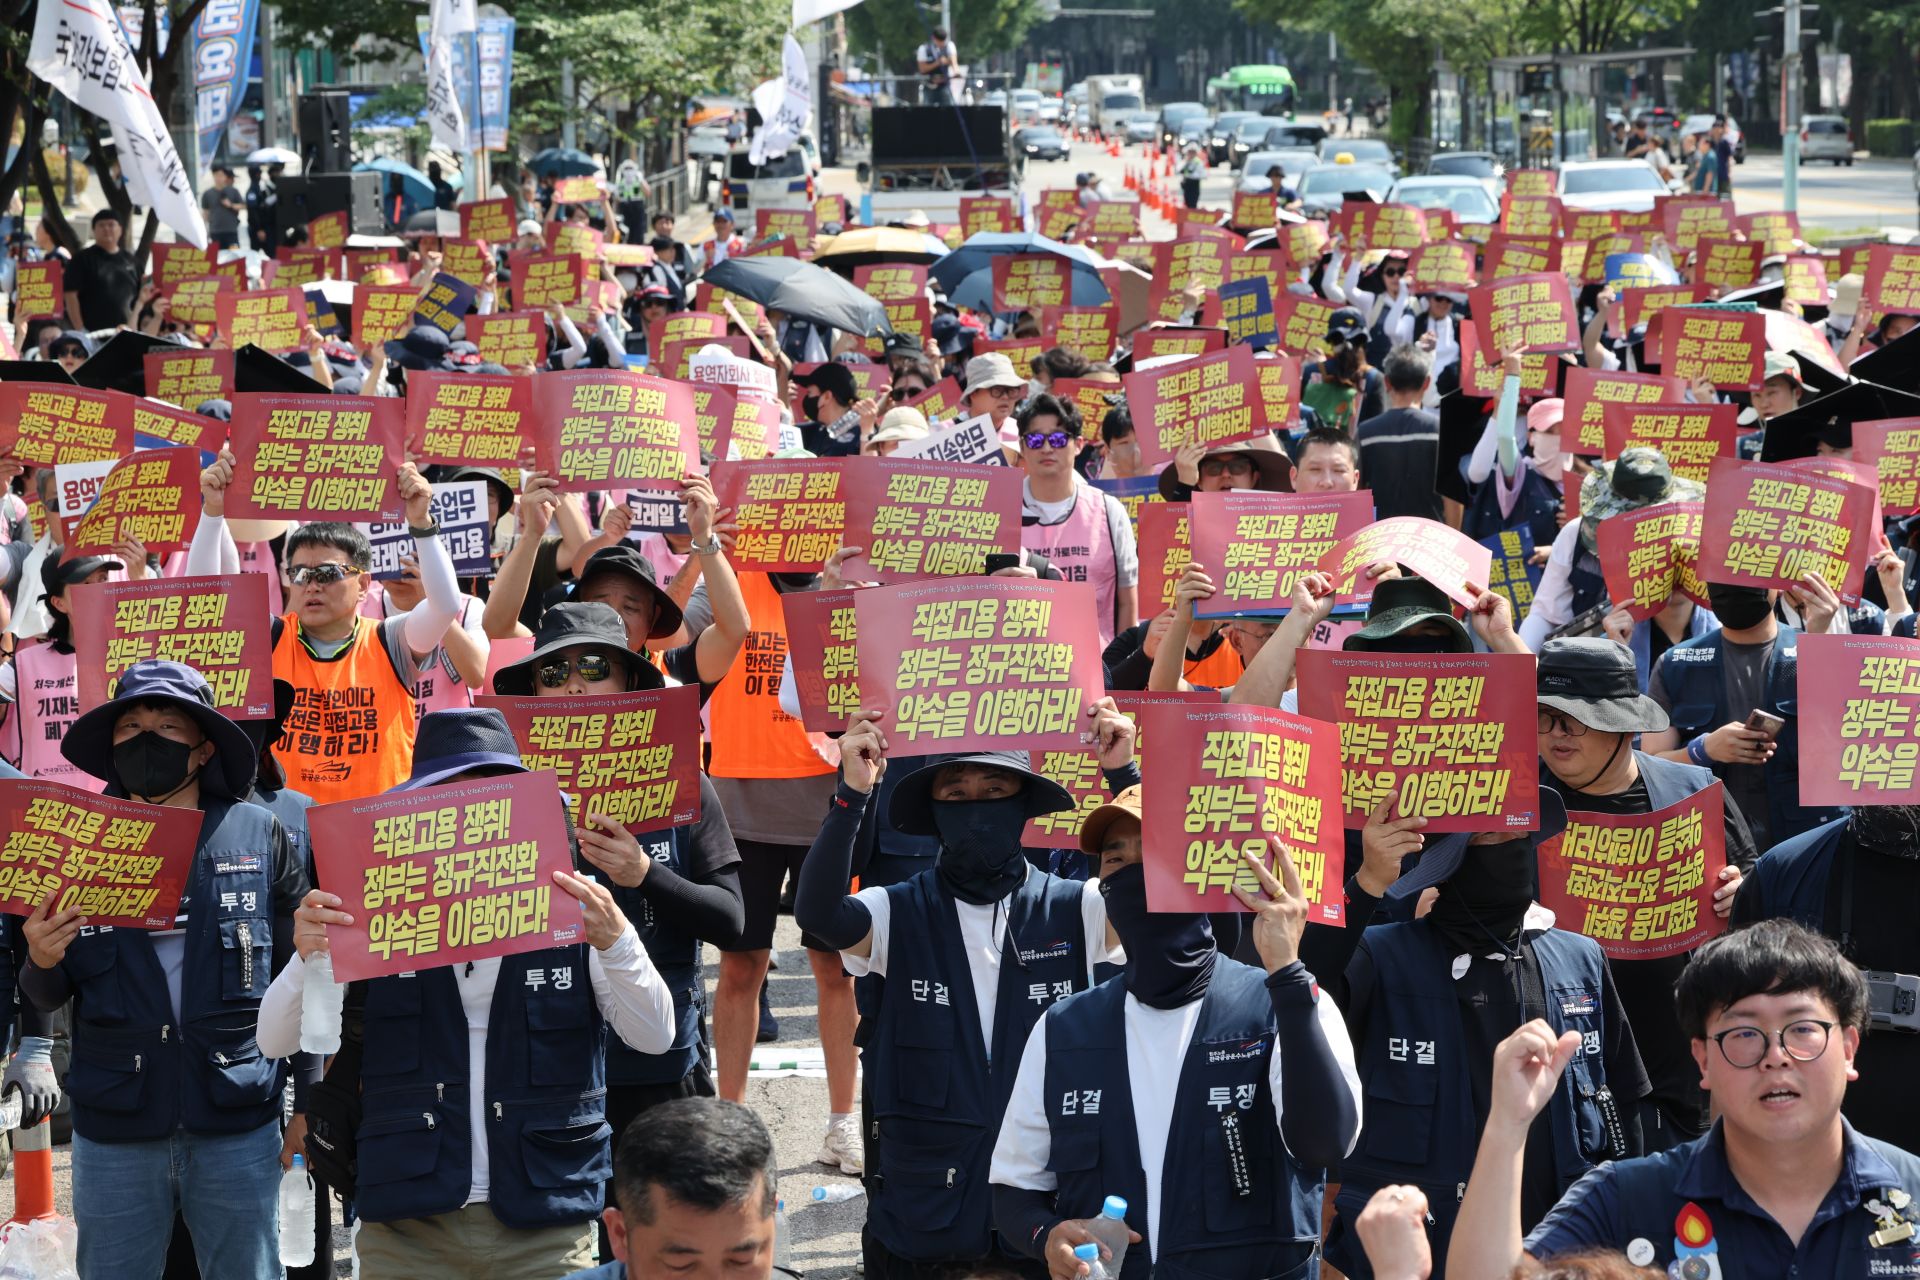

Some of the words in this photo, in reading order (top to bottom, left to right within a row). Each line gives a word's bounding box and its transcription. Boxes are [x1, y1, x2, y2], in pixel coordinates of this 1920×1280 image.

[1157, 368, 1200, 398] 직접고용
[1201, 361, 1228, 388] 쟁취!
[27, 391, 75, 420] 직접고용
[75, 399, 107, 424] 쟁취!
[436, 385, 481, 407] 직접고용
[482, 386, 512, 409] 쟁취!
[572, 384, 633, 413] 직접고용
[634, 387, 666, 416] 쟁취!
[1154, 399, 1187, 427] 정부는
[1188, 384, 1244, 417] 정규직전환
[18, 413, 53, 438] 정부는
[53, 419, 117, 448] 정규직전환
[266, 410, 331, 441] 직접고용
[335, 410, 371, 441] 쟁취!
[425, 408, 461, 430] 정부는
[460, 410, 520, 433] 정규직전환
[560, 415, 607, 445] 정부는
[609, 418, 681, 448] 정규직전환
[1198, 406, 1251, 442] 이행하라!
[1632, 415, 1680, 438] 직접고용
[1680, 415, 1711, 439] 쟁취!
[12, 437, 56, 464] 약속을
[253, 442, 301, 473] 정부는
[303, 443, 384, 475] 정규직전환
[423, 432, 464, 458] 약속을
[464, 434, 522, 460] 이행하라!
[137, 460, 170, 487] 쟁취!
[559, 448, 613, 481] 약속을
[613, 448, 688, 481] 이행하라!
[114, 486, 182, 513] 정규직전환
[250, 477, 305, 510] 약속을
[306, 478, 386, 512] 이행하라!
[746, 472, 801, 500] 직접고용
[805, 471, 840, 498] 쟁취!
[886, 474, 950, 504] 직접고용
[950, 477, 989, 508] 쟁취!
[1747, 478, 1810, 513] 직접고용
[1809, 489, 1845, 521] 쟁취!
[118, 513, 186, 543] 이행하라!
[630, 500, 675, 527] 코레일
[735, 502, 779, 530] 정부는
[872, 506, 920, 536] 정부는
[922, 508, 1000, 541] 정규직전환
[1235, 513, 1300, 541] 직접고용
[1300, 512, 1337, 539] 쟁취!
[1634, 513, 1690, 544] 직접고용
[734, 533, 780, 563] 약속을
[1729, 508, 1780, 541] 정부는
[1780, 514, 1852, 556] 정규직전환
[868, 539, 921, 573] 약속을
[1224, 541, 1271, 569] 정부는
[1628, 544, 1667, 578] 정부는
[1723, 540, 1782, 578] 약속을
[1223, 569, 1279, 601] 약속을
[115, 594, 182, 634] 직접고용
[185, 593, 227, 629] 쟁취!
[912, 598, 999, 643] 직접고용
[1001, 599, 1052, 638] 쟁취!
[155, 630, 245, 668] 정규직전환
[745, 631, 786, 652] 해고는
[745, 652, 786, 674] 한전은
[896, 645, 963, 690] 정부는
[965, 643, 1073, 685] 정규직전환
[321, 687, 376, 710] 살인이다
[895, 690, 972, 741] 약속을
[974, 688, 1082, 736] 이행하라!
[1345, 676, 1427, 719] 직접고용
[1430, 676, 1485, 718] 쟁취!
[323, 708, 378, 734] 직접고용
[528, 714, 607, 750] 직접고용
[610, 709, 657, 744] 쟁취!
[1840, 697, 1909, 739] 정부는
[1201, 730, 1282, 780] 직접고용
[1282, 735, 1311, 788] 쟁취!
[1391, 722, 1505, 766] 정규직전환
[300, 772, 342, 783] 공공운수노조
[576, 743, 675, 789] 정규직전환
[1039, 751, 1100, 789] 정부는
[1838, 743, 1913, 791] 약속을
[1397, 770, 1511, 818] 이행하라!
[23, 796, 106, 846] 직접고용
[104, 815, 157, 853] 쟁취!
[373, 806, 456, 860] 직접고용
[462, 798, 512, 842] 쟁취!
[1184, 785, 1257, 833] 정부는
[1260, 785, 1323, 845] 정규직전환
[1561, 820, 1655, 867] 이행하라!
[1655, 806, 1704, 863] 약속을
[0, 831, 64, 871] 정부는
[63, 842, 164, 889] 정규직전환
[363, 861, 427, 911] 정부는
[432, 840, 538, 899] 정규직전환
[1183, 838, 1268, 895] 약속을
[1662, 849, 1705, 898] 정부는
[56, 884, 161, 919] 이행하라!
[219, 890, 258, 913] 투쟁
[1566, 865, 1662, 904] 정규직전환
[368, 903, 441, 962] 약속을
[446, 885, 551, 948] 이행하라!
[1583, 905, 1628, 942] 쟁취!
[1629, 896, 1699, 942] 직접고용
[524, 965, 573, 993] 투쟁
[911, 979, 951, 1007] 단결
[1028, 979, 1073, 1006] 투쟁
[1388, 1037, 1436, 1065] 단결
[1575, 1029, 1601, 1056] 쟁
[1062, 1089, 1102, 1117] 단결
[1206, 1083, 1258, 1113] 투쟁
